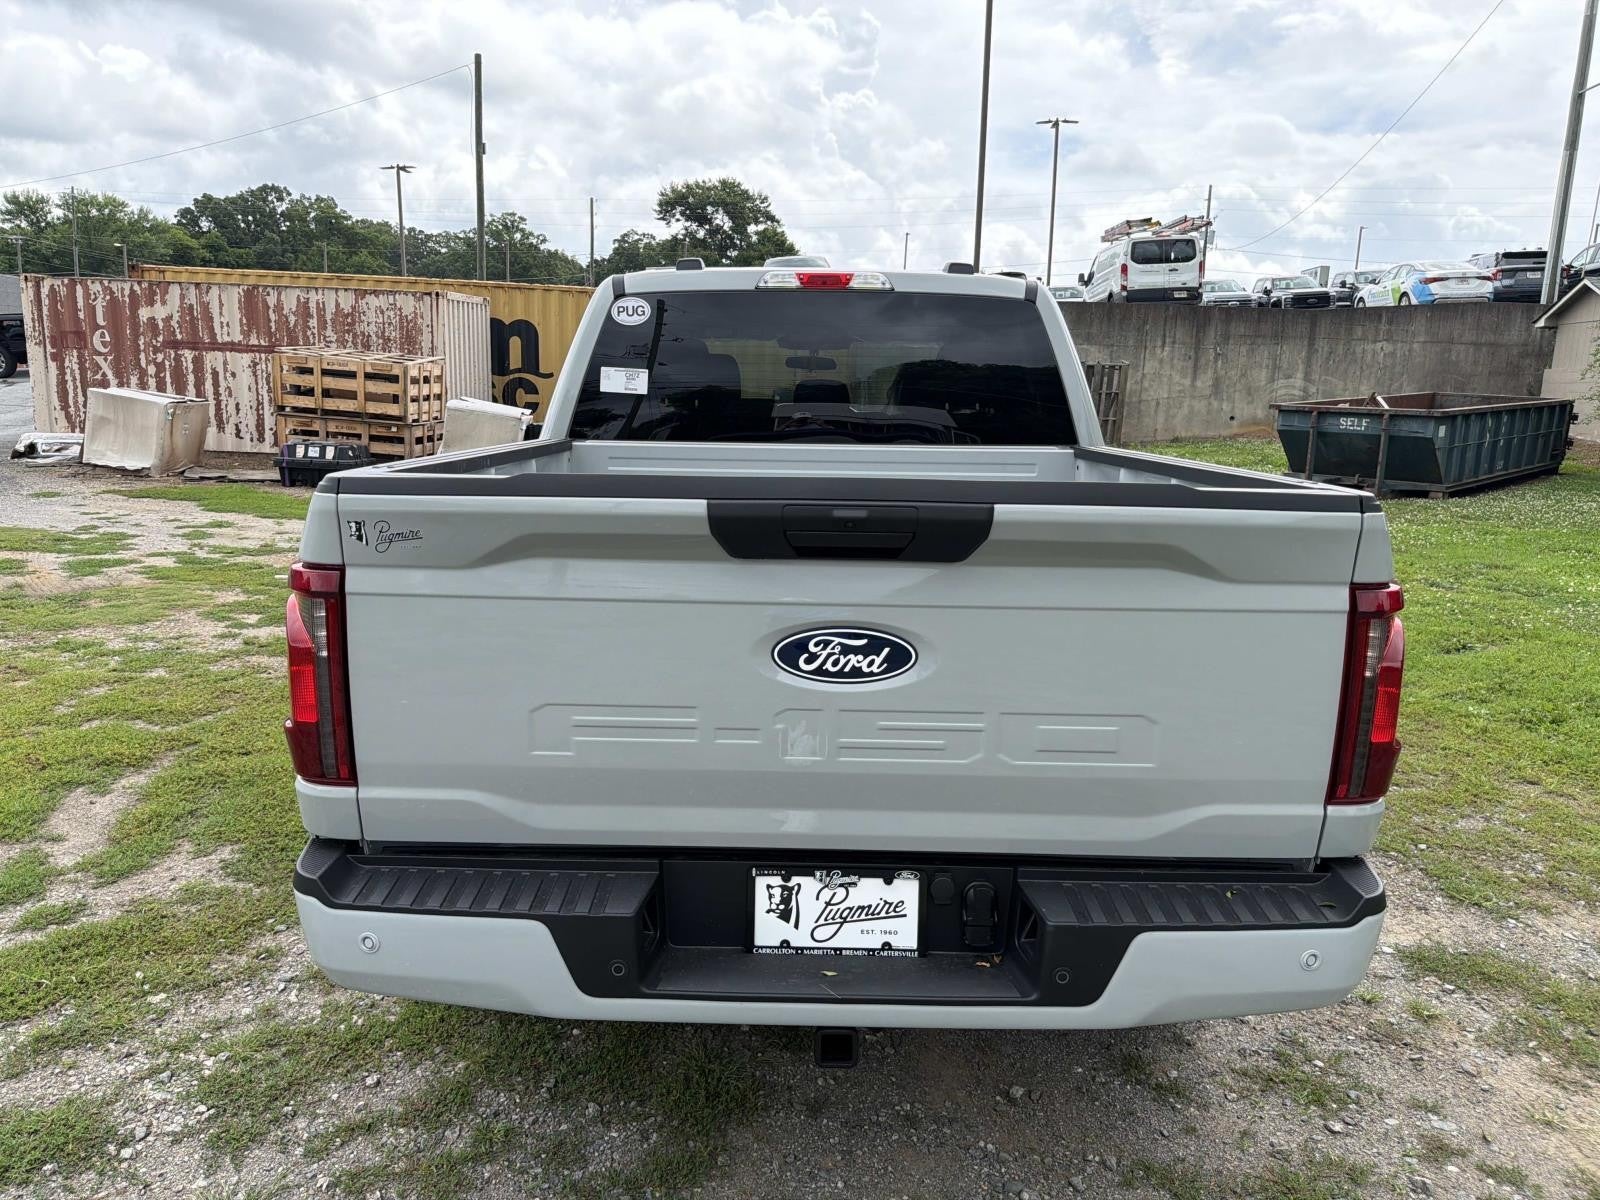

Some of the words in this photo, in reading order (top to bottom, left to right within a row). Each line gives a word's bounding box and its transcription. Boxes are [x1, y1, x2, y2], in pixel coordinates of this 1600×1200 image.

[616, 305, 646, 318] PUG
[1339, 417, 1370, 431] SELF
[373, 519, 424, 554] Pugmire
[798, 635, 891, 673] Ford
[528, 703, 1160, 769] F-150
[810, 885, 908, 943] Pugmire
[752, 947, 797, 955] CARROLLTON
